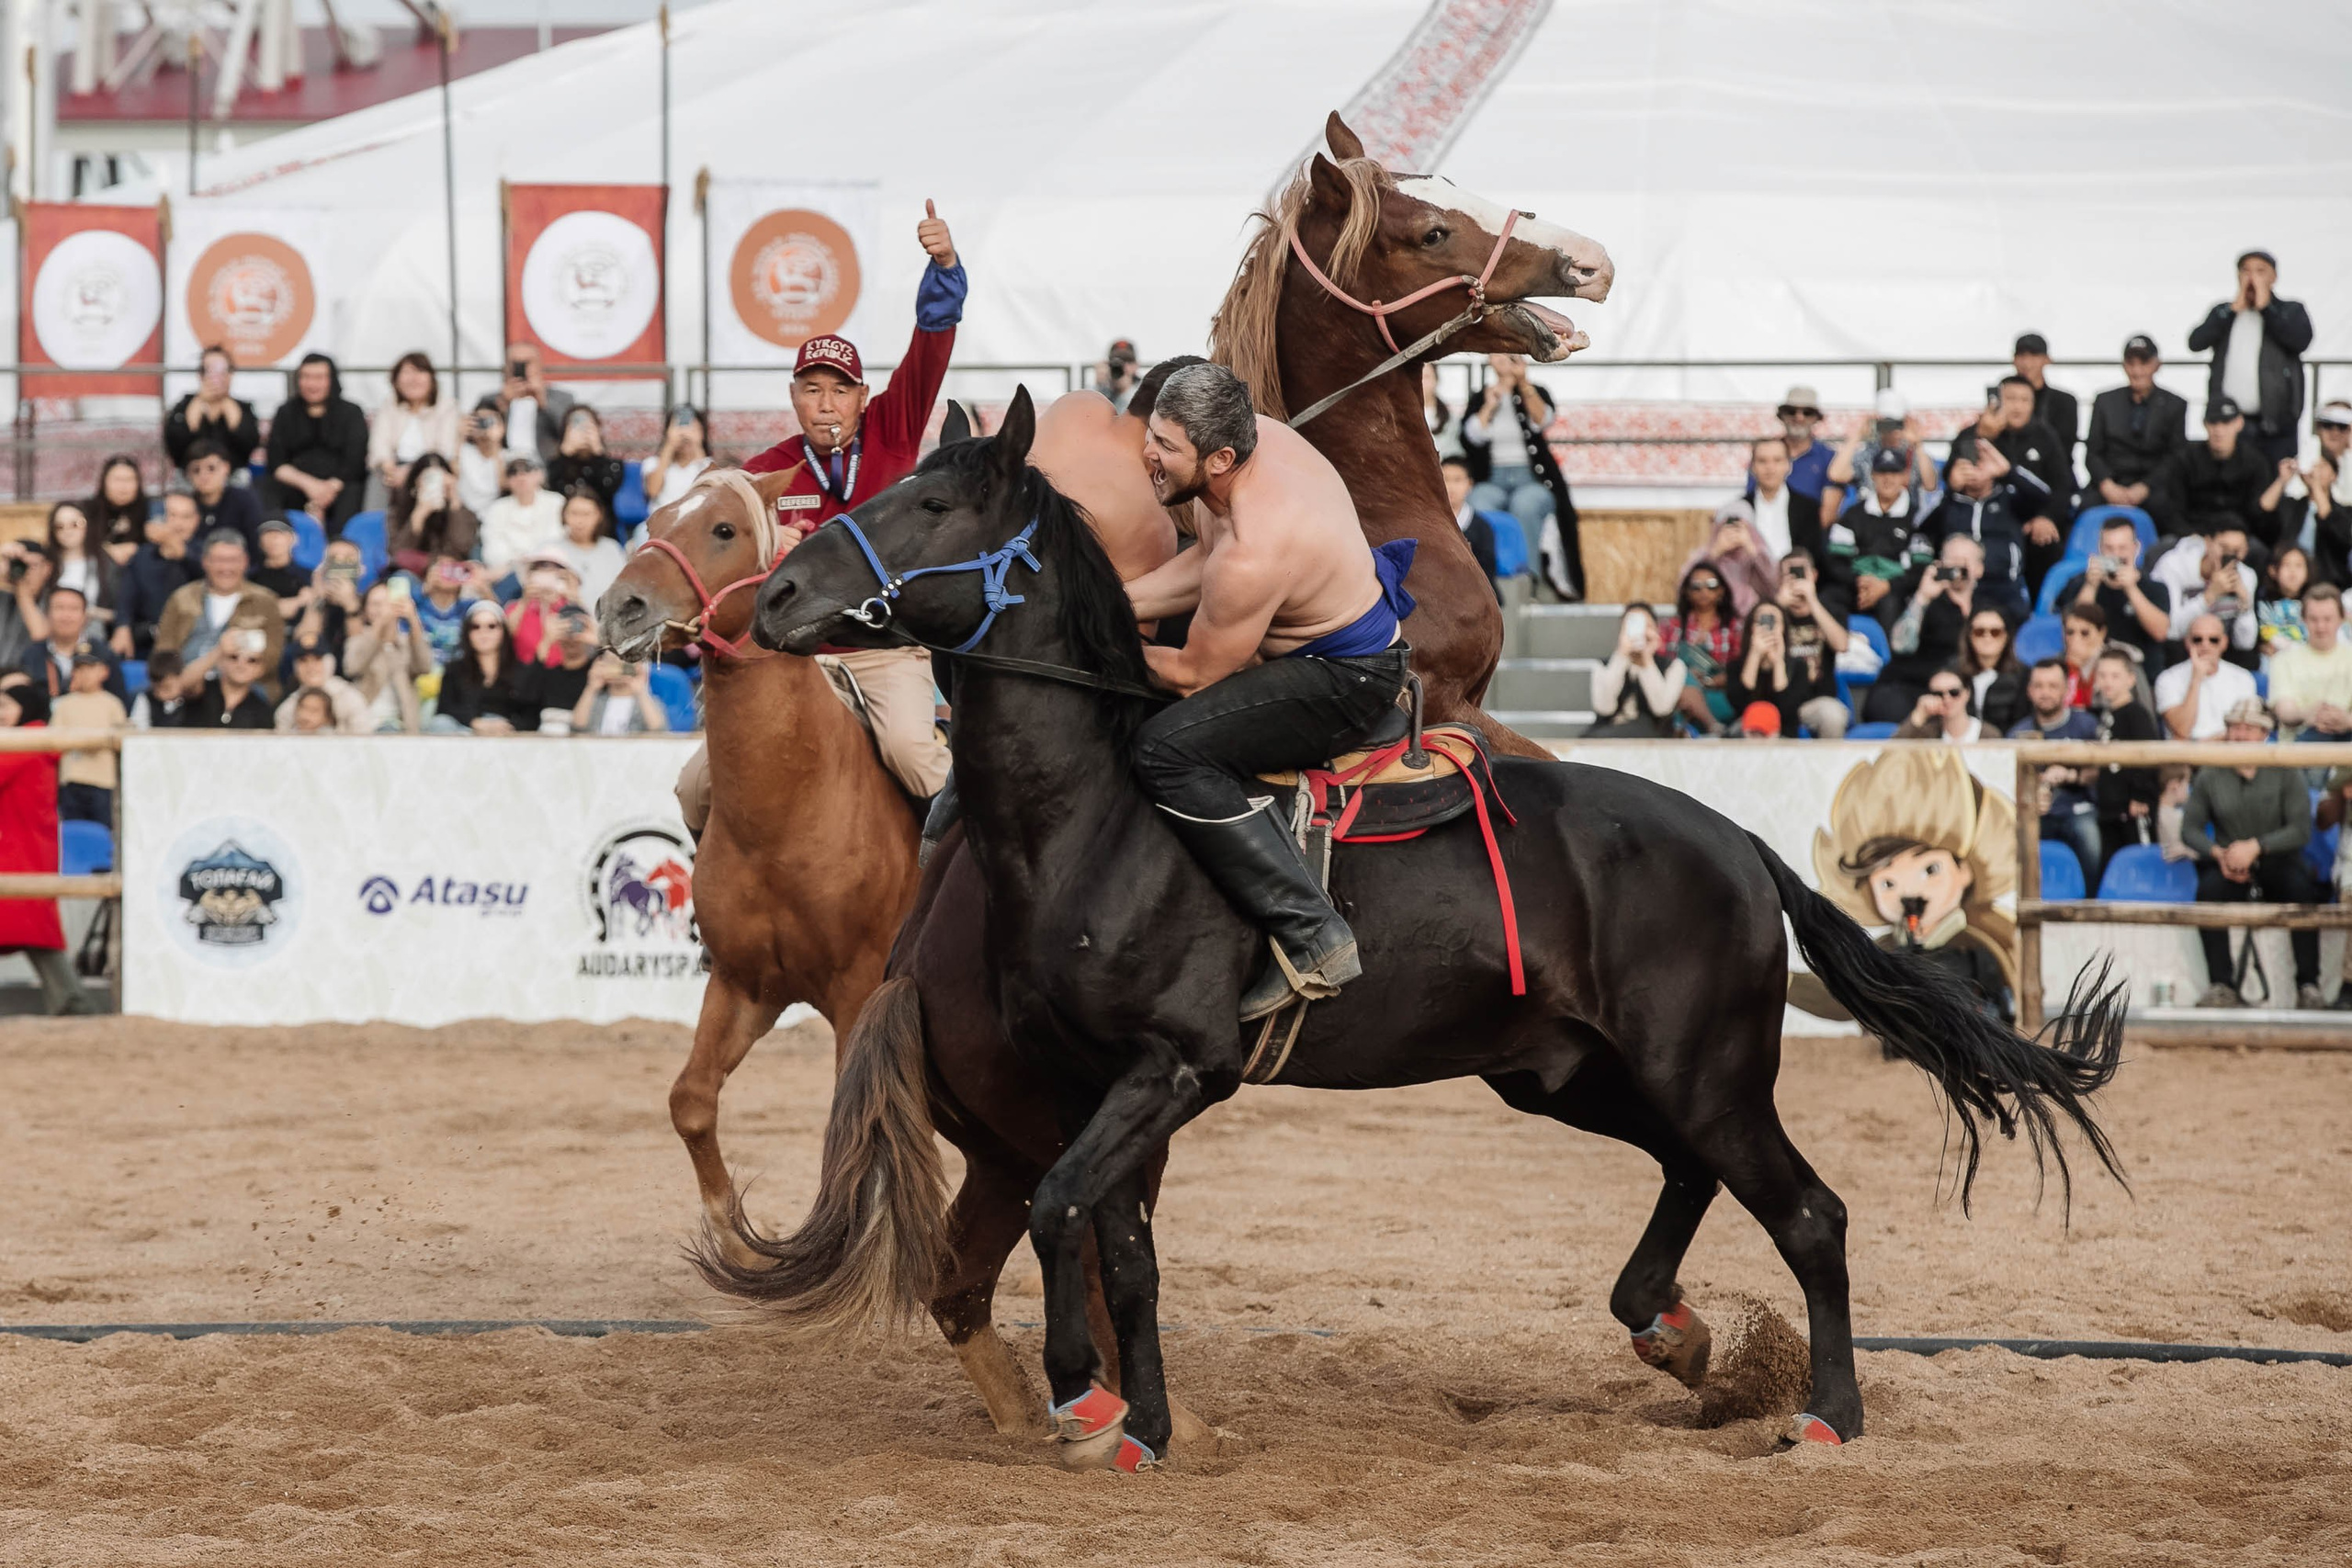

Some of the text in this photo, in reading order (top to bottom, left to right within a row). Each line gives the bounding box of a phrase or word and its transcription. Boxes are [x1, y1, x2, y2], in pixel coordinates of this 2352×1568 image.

[805, 348, 854, 366] REPUBLIC
[806, 338, 854, 357] KYRGYZ
[780, 497, 819, 508] REFEREE
[410, 876, 527, 905] Atasu
[577, 953, 706, 976] AUDARYSPA
